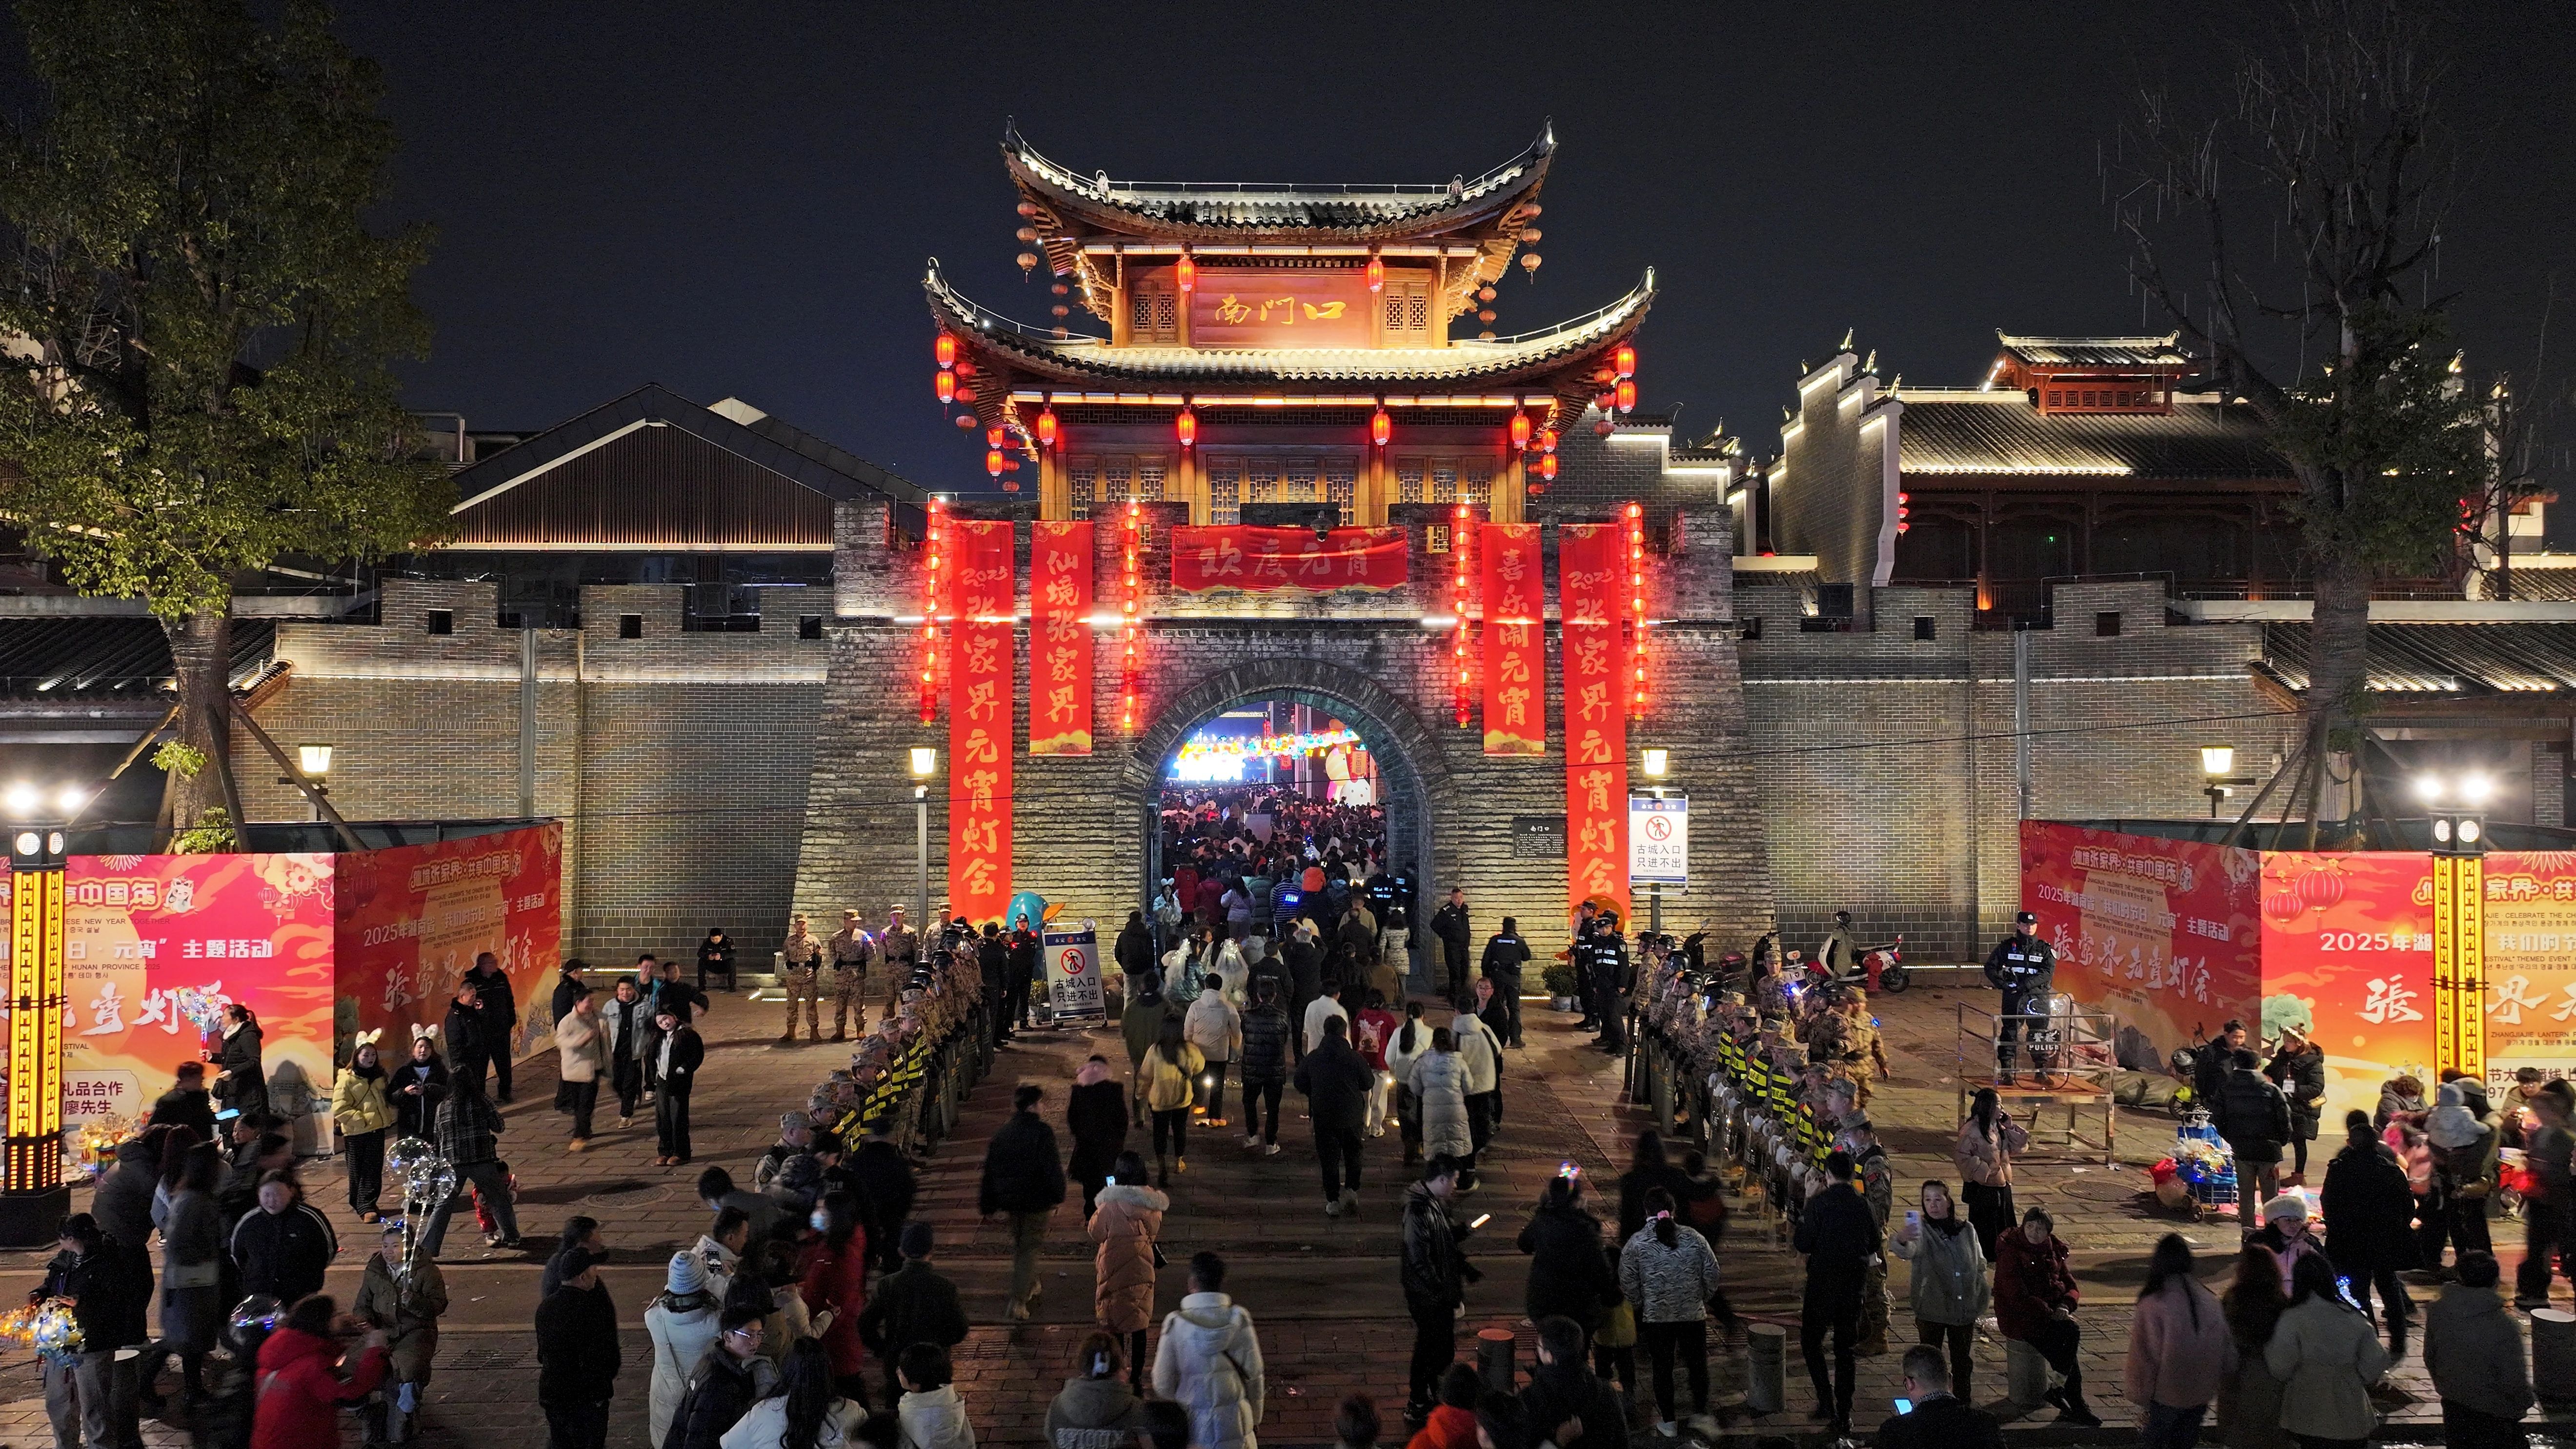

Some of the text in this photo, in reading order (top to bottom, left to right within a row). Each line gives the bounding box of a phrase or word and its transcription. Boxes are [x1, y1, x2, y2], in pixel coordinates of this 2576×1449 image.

[1198, 538, 1373, 578] 欢度元宵
[960, 565, 1008, 589] 2025
[1567, 568, 1614, 591] 2025
[1045, 550, 1079, 724] 仙境张家界
[1497, 548, 1530, 726] 喜乐闹元宵
[961, 595, 1001, 895] 张家界元宵灯会
[1577, 598, 1617, 894] 张家界元宵灯会
[1636, 844, 1680, 854] 古城入口
[1637, 857, 1680, 868] 只进不出
[517, 892, 544, 913] 主题活动
[2187, 916, 2229, 942] 主题活动
[182, 939, 273, 959] 主题活动
[2320, 933, 2433, 951] 2025年湖
[1055, 977, 1096, 989] 古城入口
[1057, 989, 1098, 1003] 只进不出
[64, 1100, 112, 1115] 廖先生
